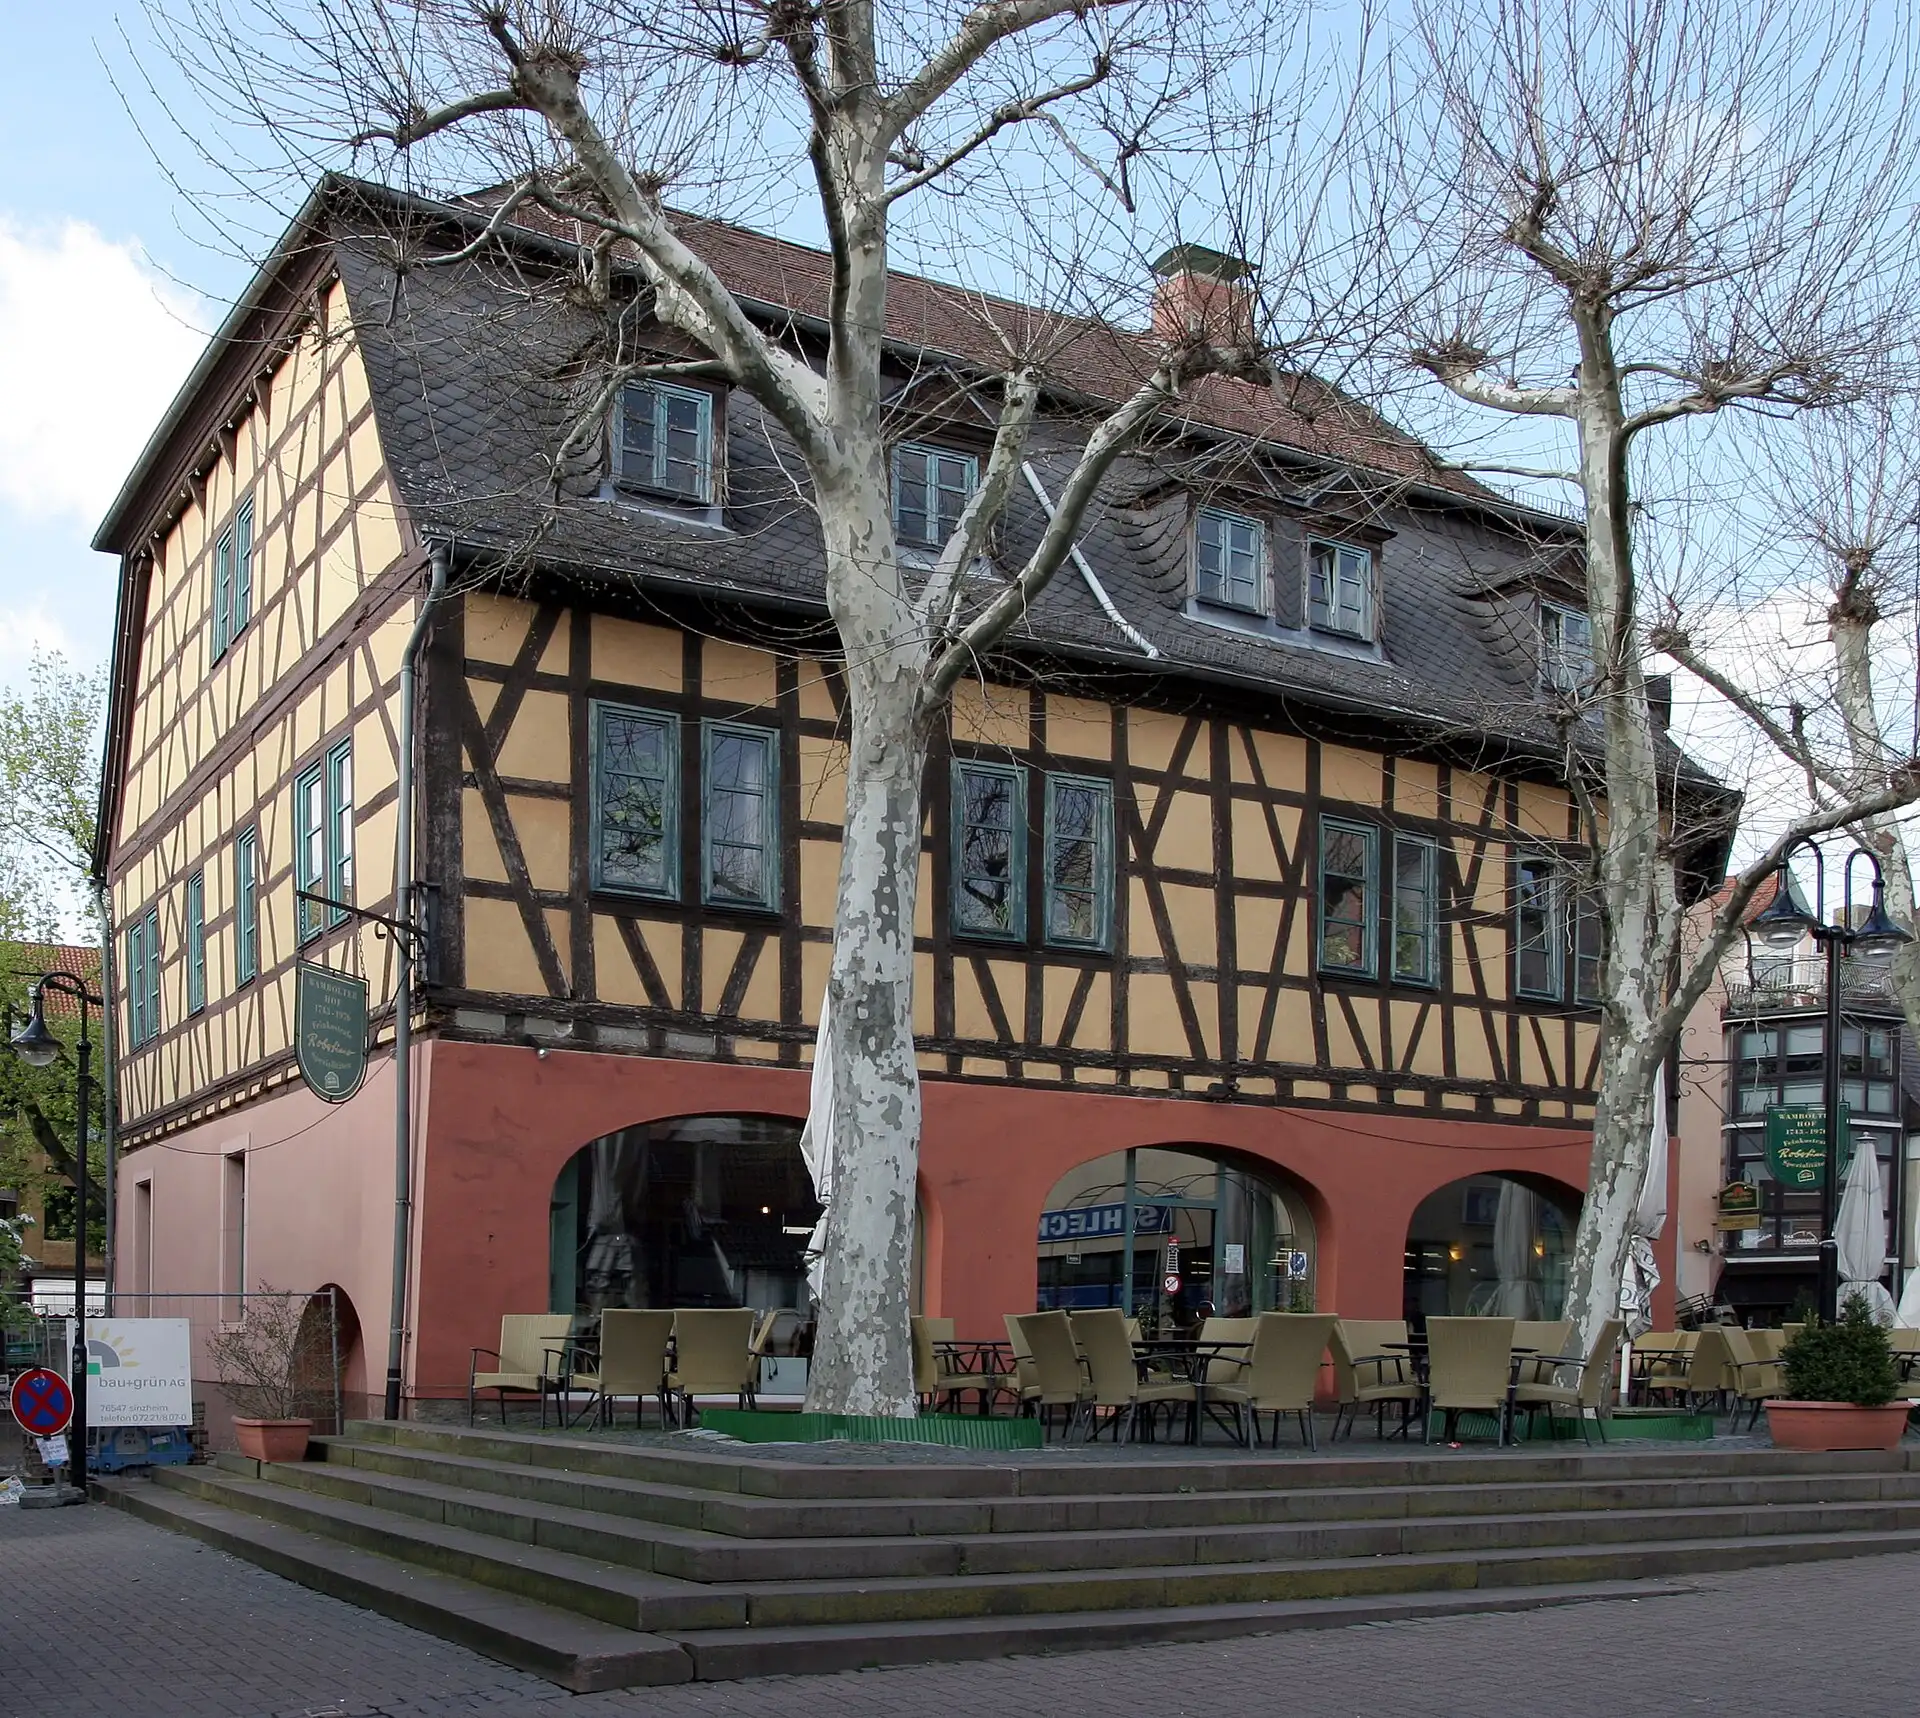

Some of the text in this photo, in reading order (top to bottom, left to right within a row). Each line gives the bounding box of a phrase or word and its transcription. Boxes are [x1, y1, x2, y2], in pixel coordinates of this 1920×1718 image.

[99, 1376, 186, 1390] bau+grün AG
[100, 1404, 169, 1412] 76547 sinzheim
[100, 1414, 132, 1422] telefon
